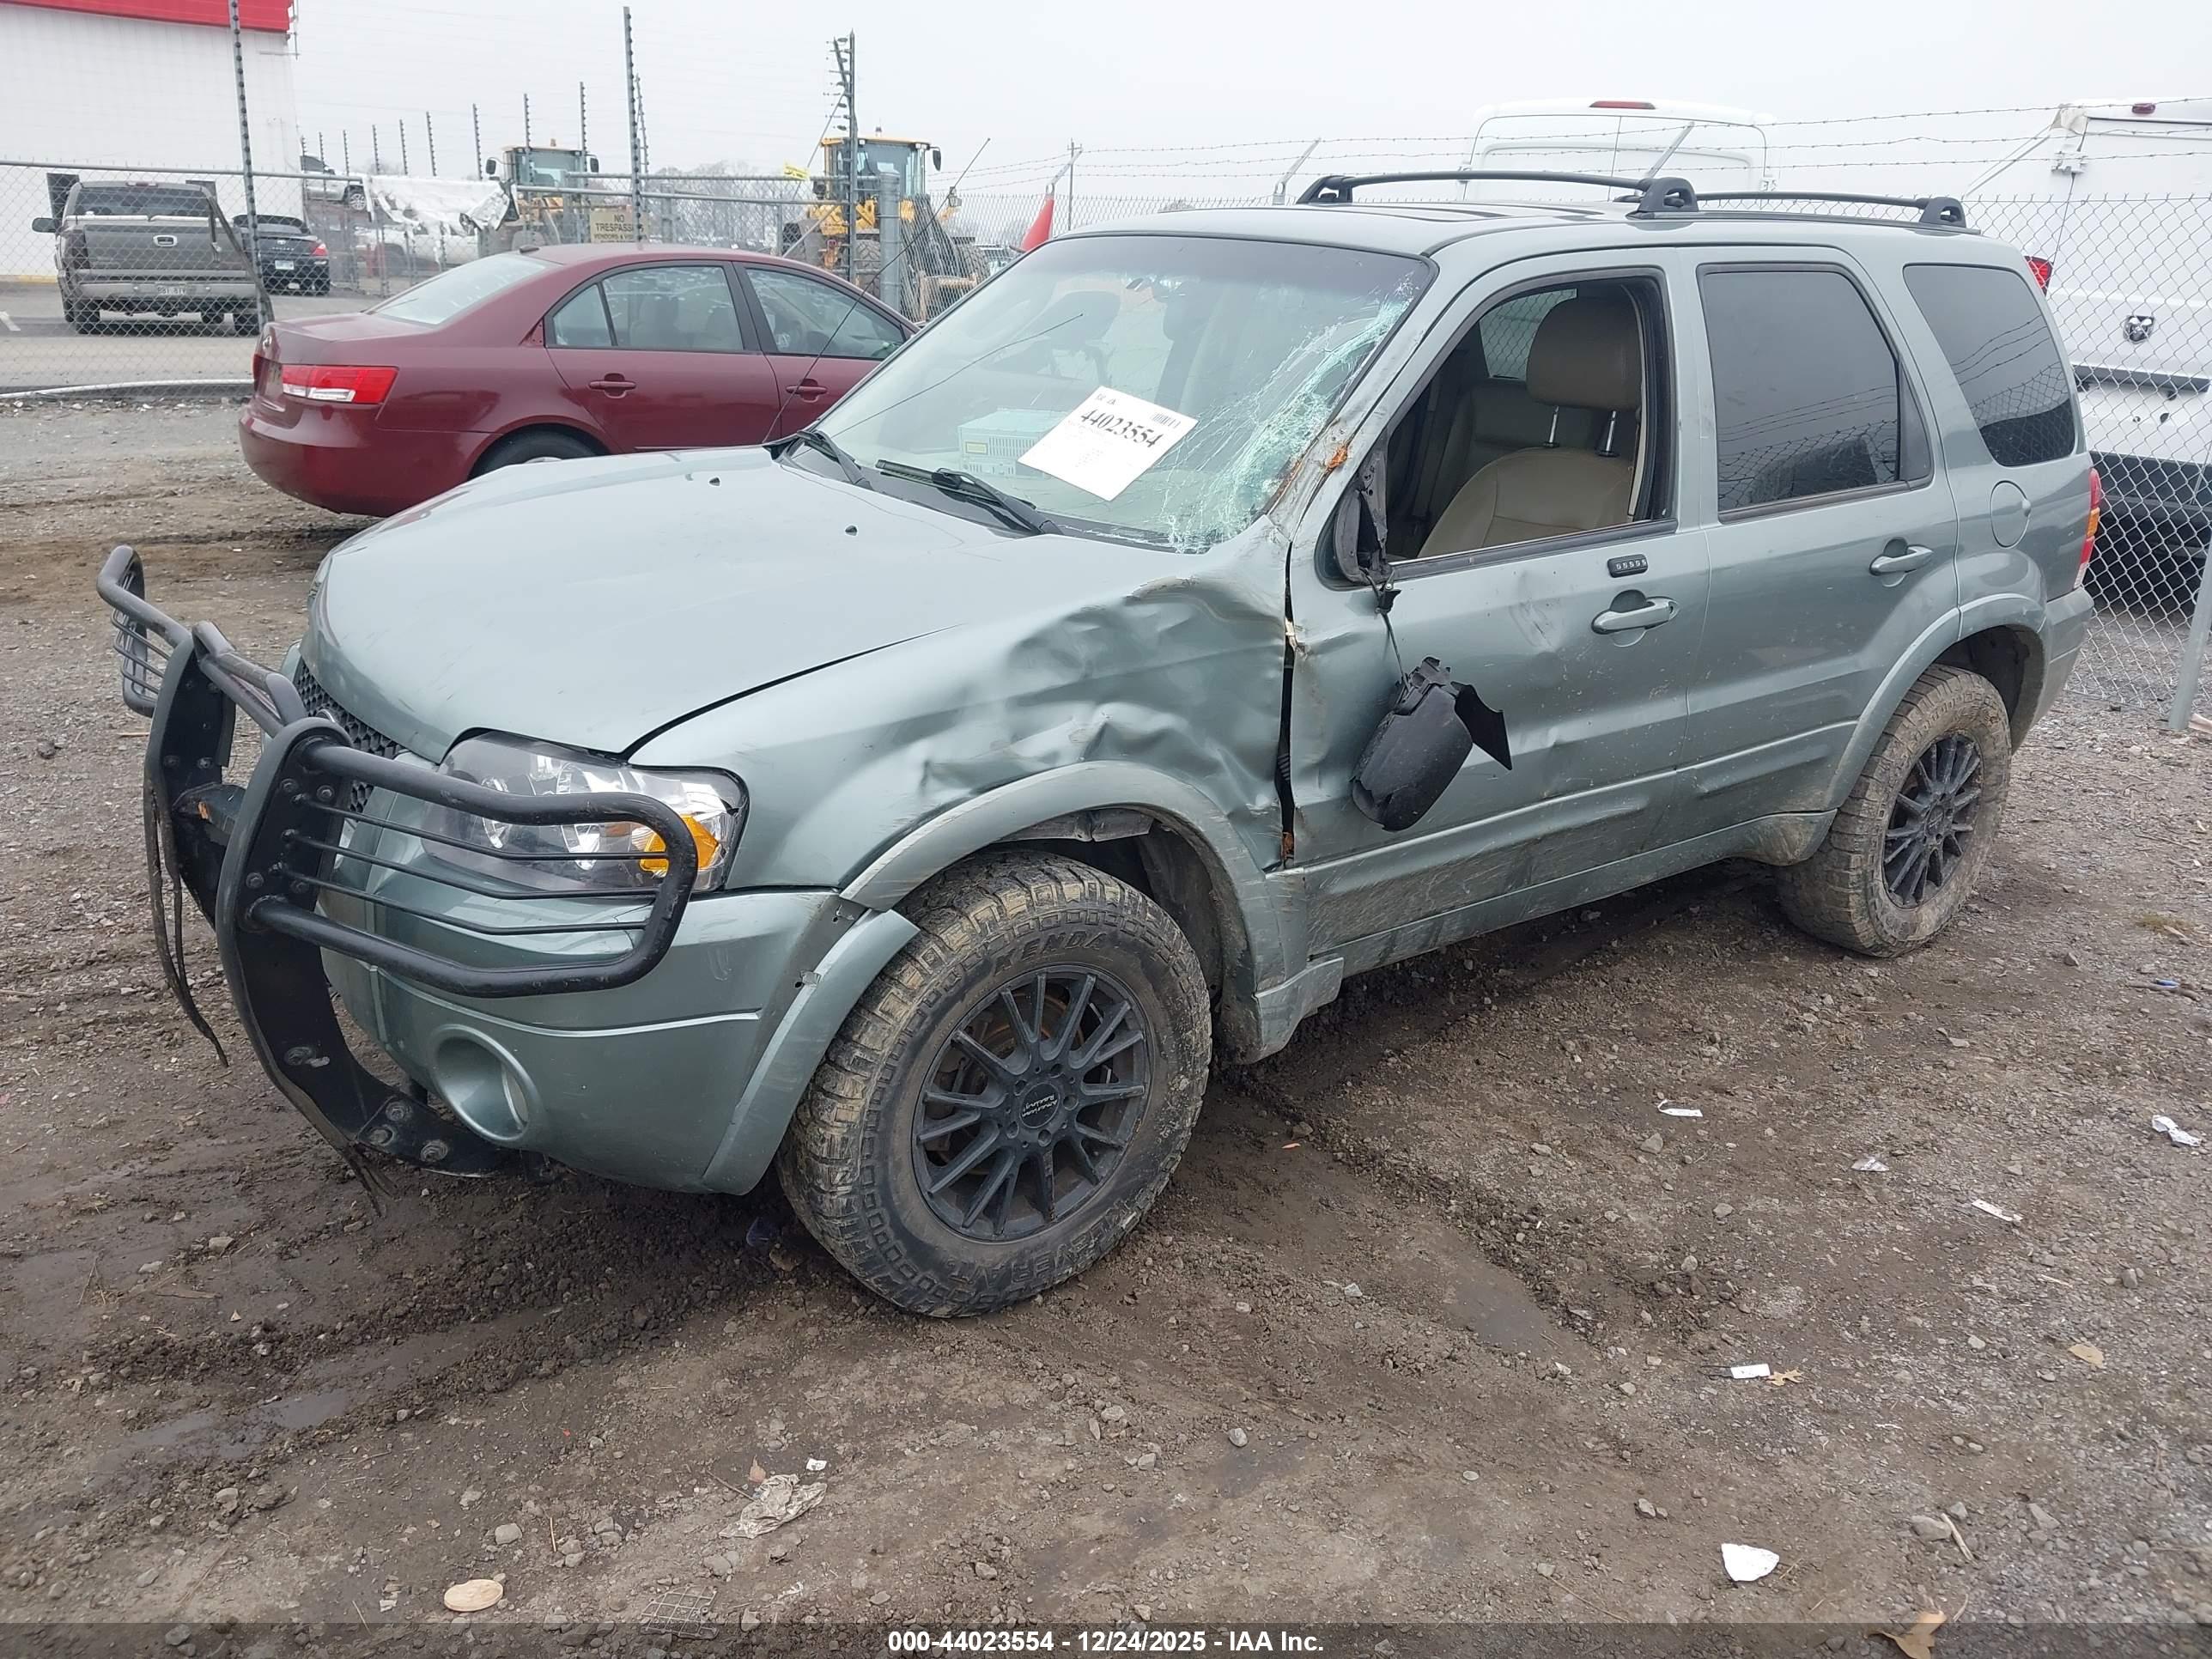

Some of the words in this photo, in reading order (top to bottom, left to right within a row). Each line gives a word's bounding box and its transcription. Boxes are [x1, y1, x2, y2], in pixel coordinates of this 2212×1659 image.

[614, 214, 624, 223] NO
[1080, 410, 1164, 448] 44023554
[994, 931, 1109, 976] KENDA
